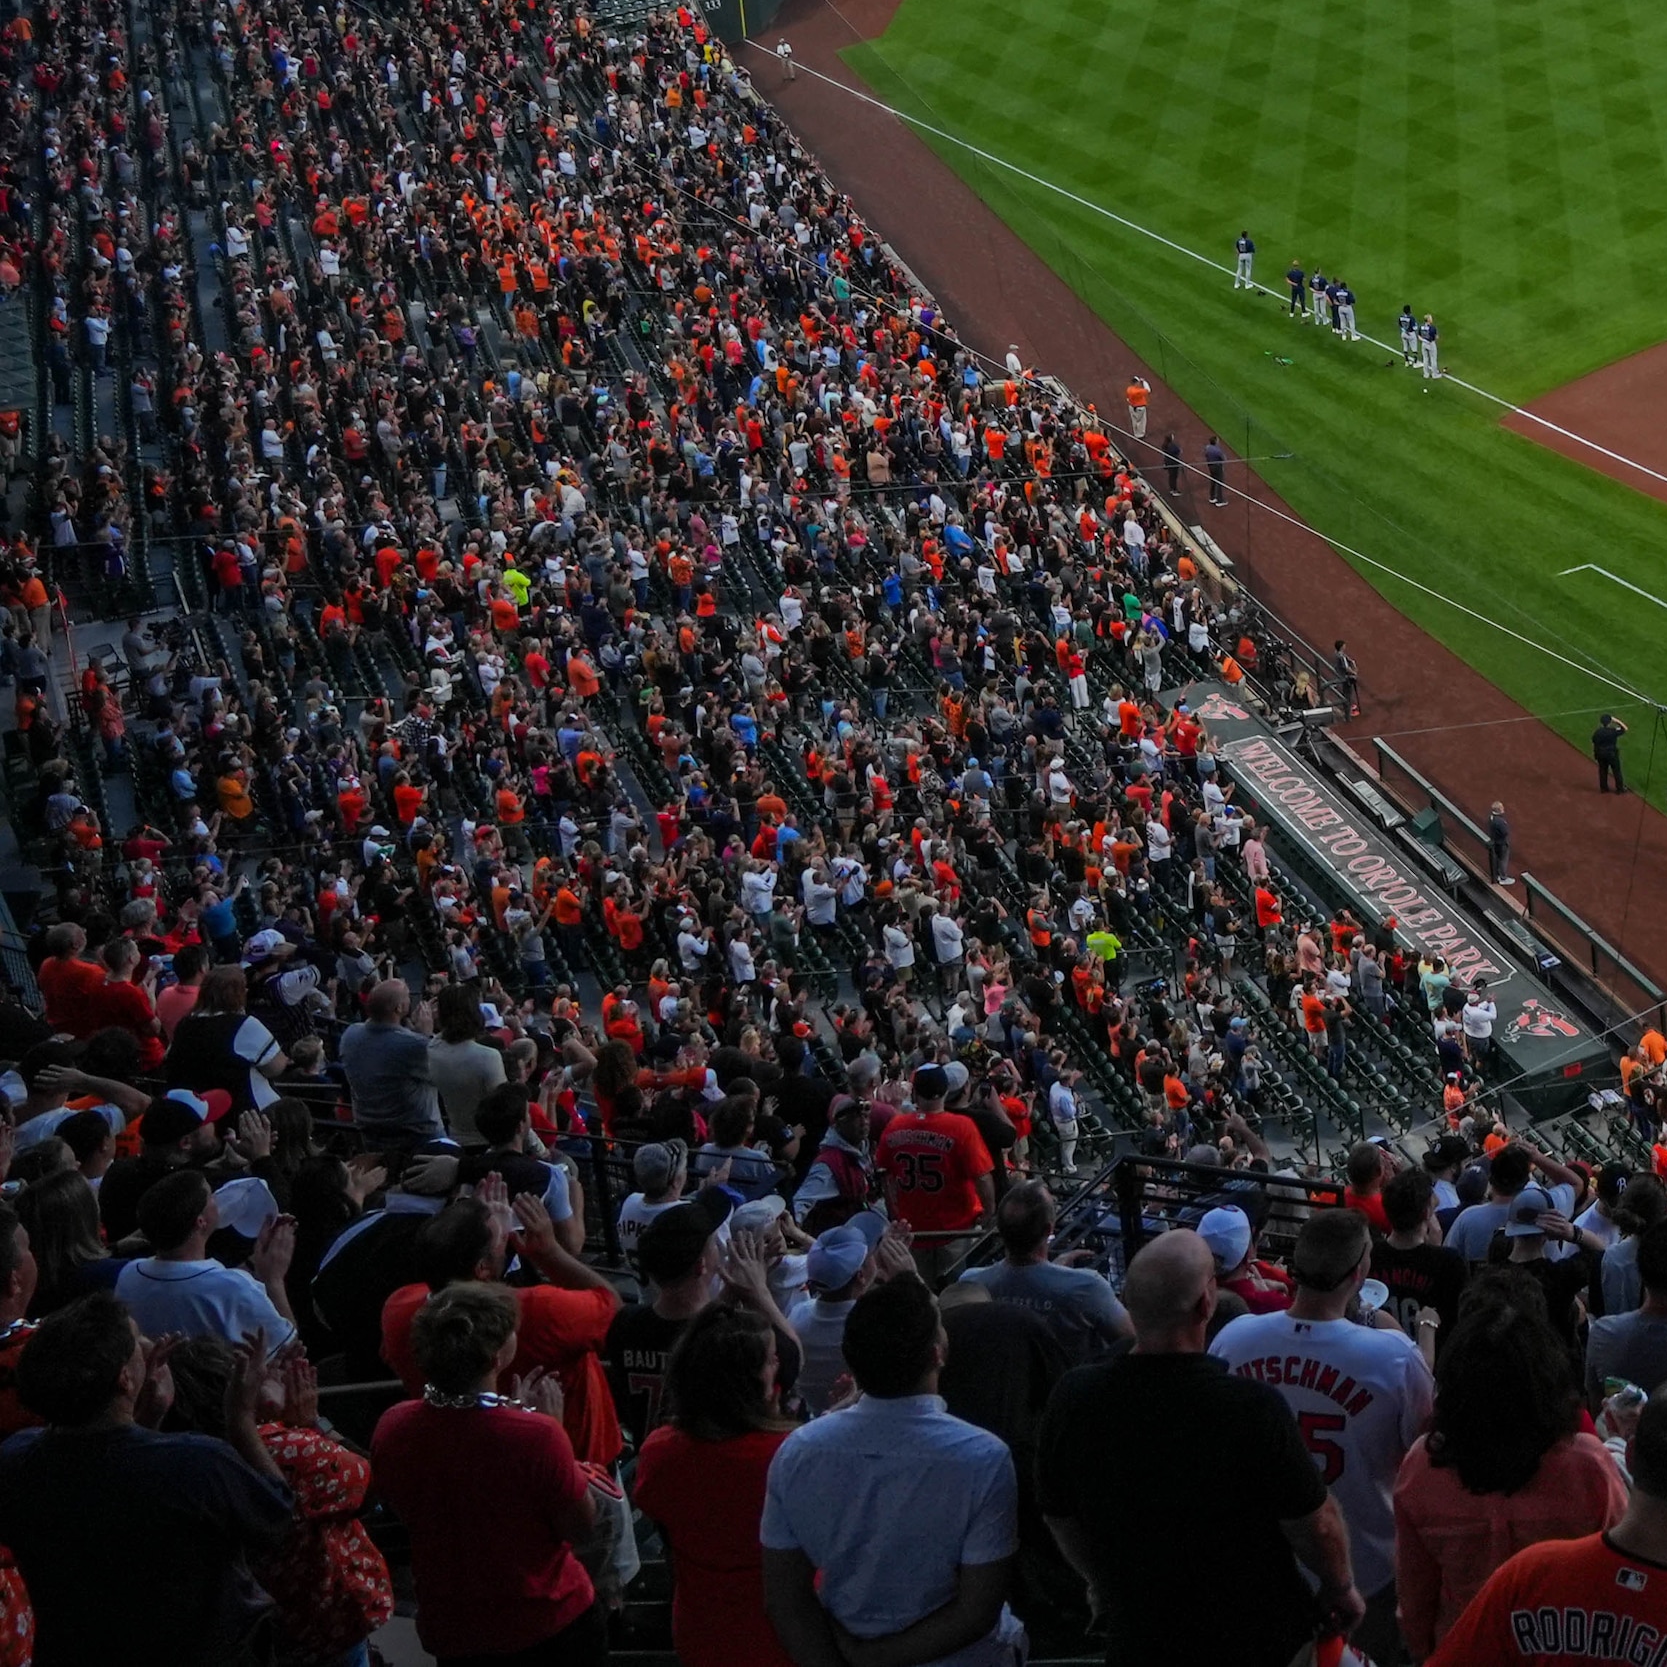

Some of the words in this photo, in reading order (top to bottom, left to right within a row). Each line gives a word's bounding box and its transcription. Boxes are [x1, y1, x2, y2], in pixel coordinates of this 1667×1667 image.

[1236, 739, 1343, 832] WELCOME
[1319, 826, 1368, 857] TO
[1347, 853, 1443, 930] ORIOLE
[1416, 922, 1500, 985] PARK
[895, 1154, 944, 1192] 35
[628, 1373, 665, 1437] 7
